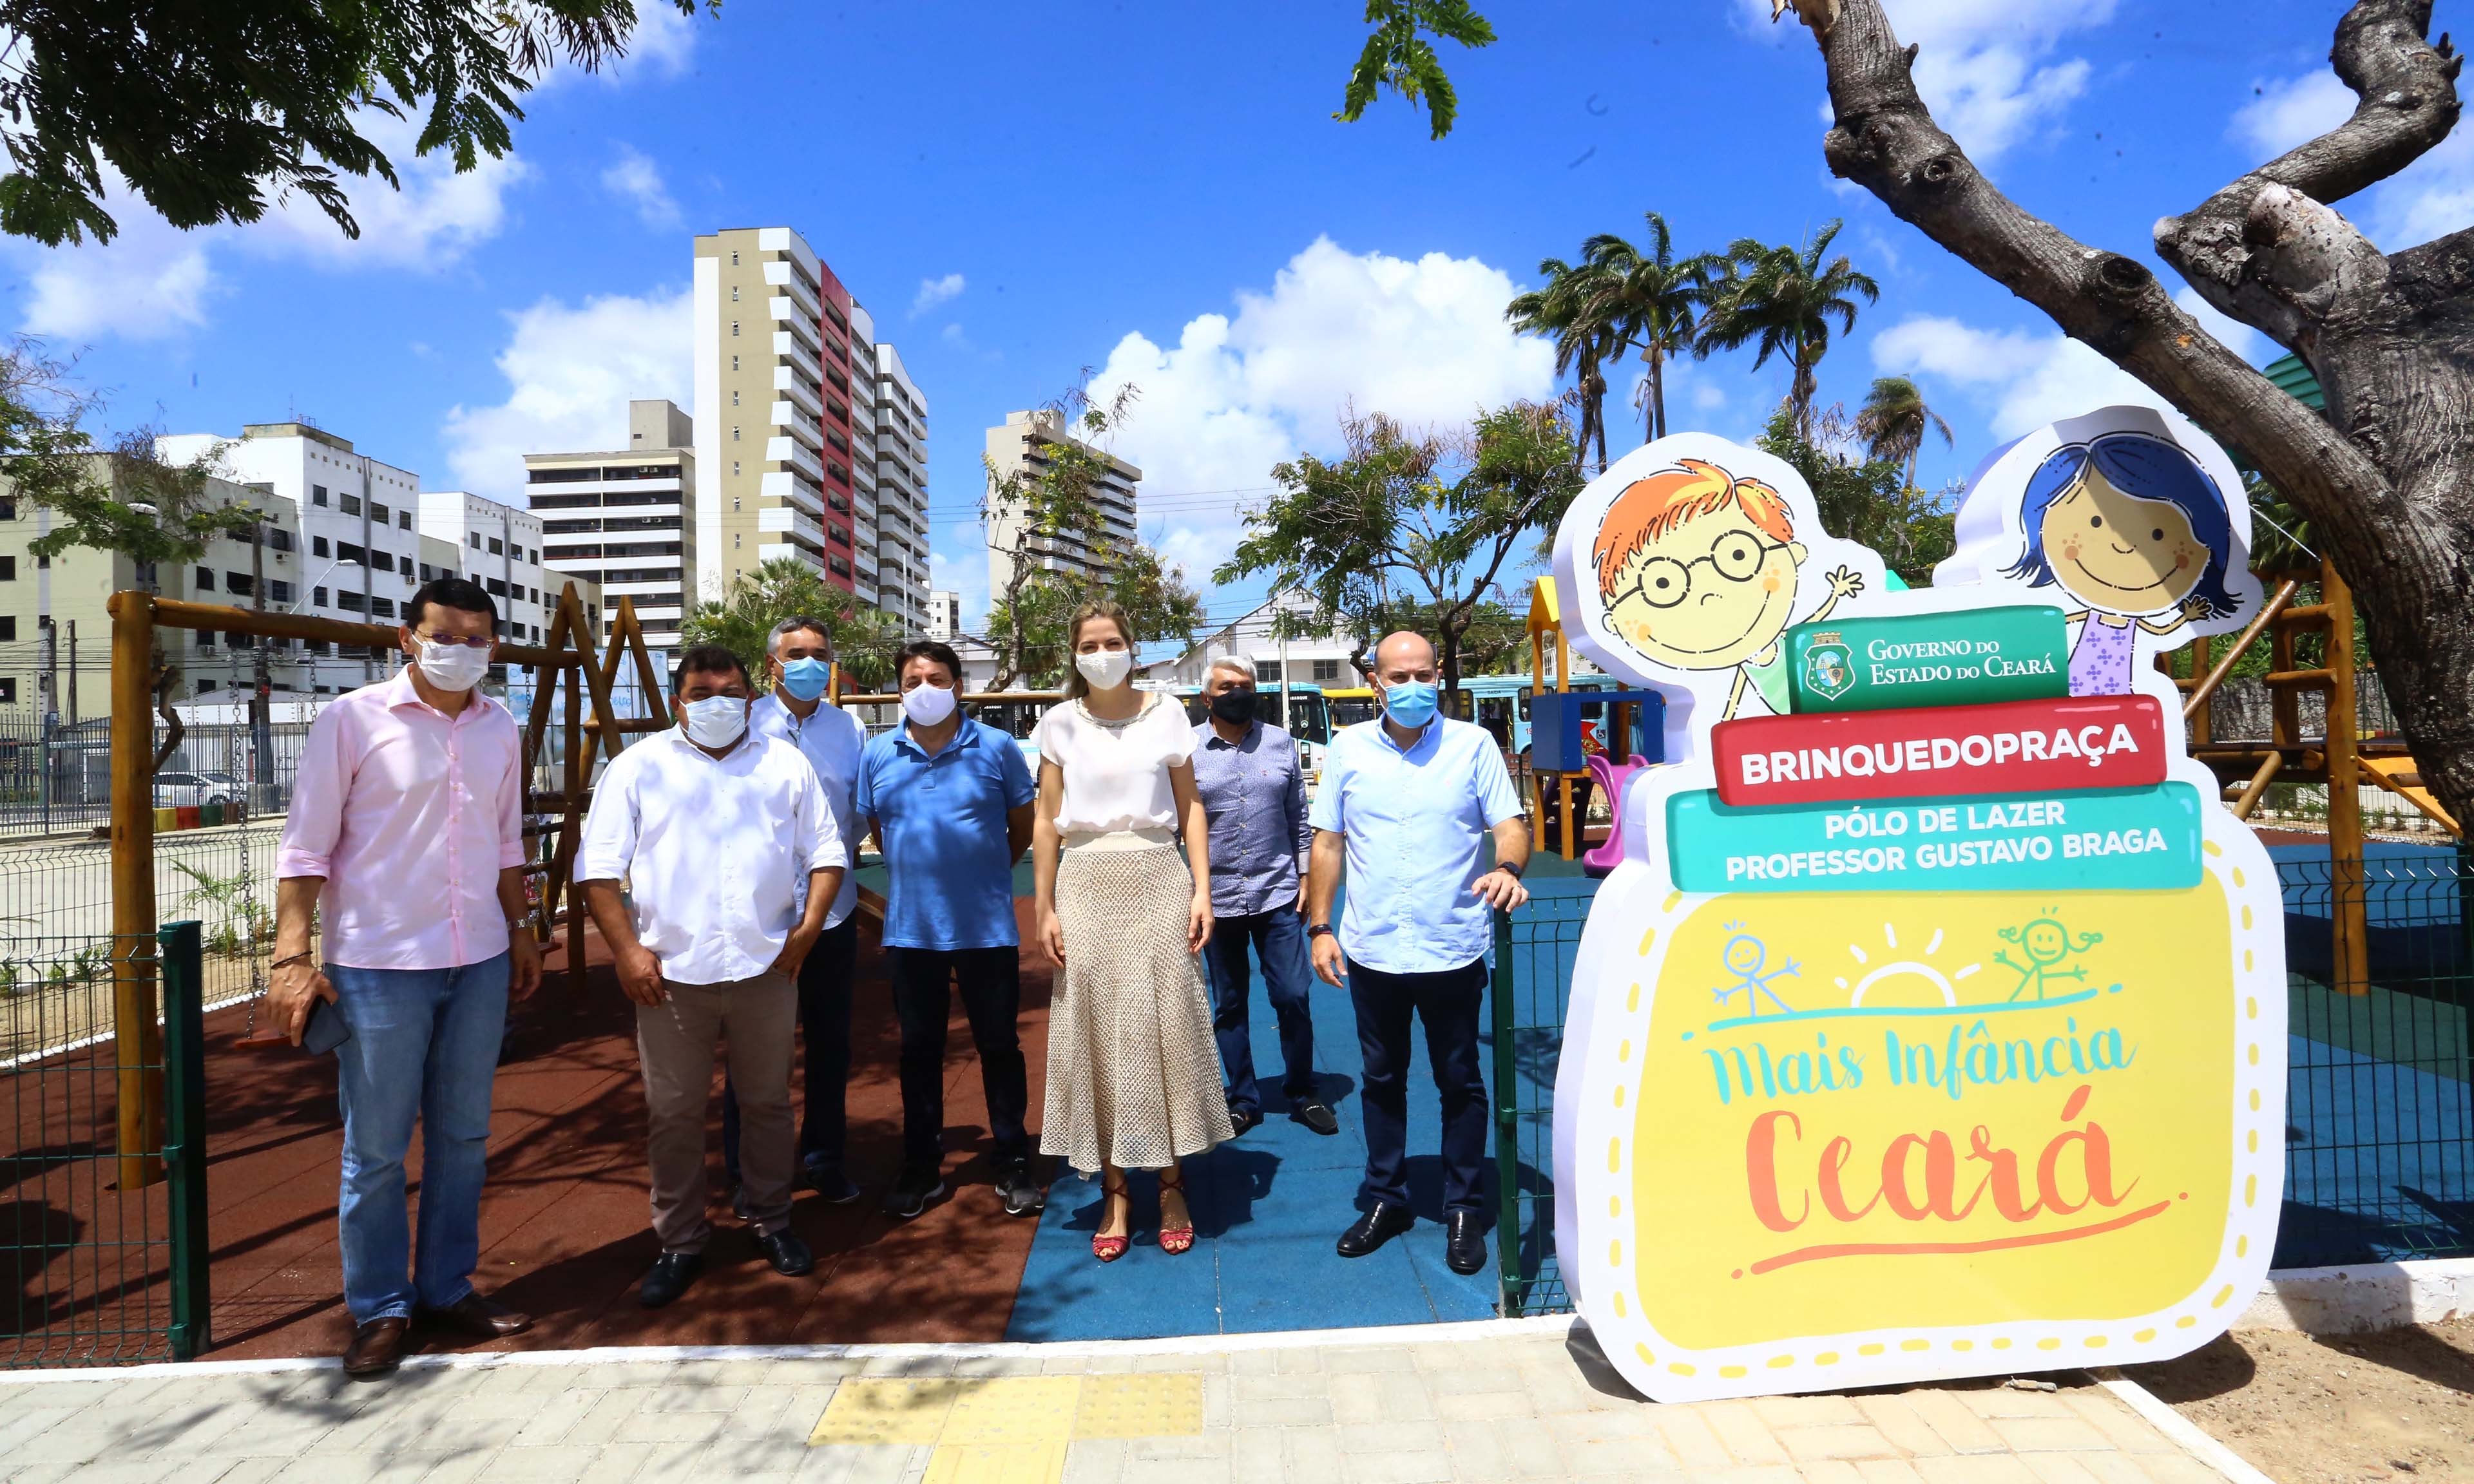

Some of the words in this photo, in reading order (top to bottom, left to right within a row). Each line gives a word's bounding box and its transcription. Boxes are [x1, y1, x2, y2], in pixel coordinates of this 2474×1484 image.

[1868, 639, 1971, 661] GOVERNO
[1868, 663, 1951, 685] ESTADO
[1984, 652, 2057, 678] CEARÁ
[1740, 723, 2140, 786] BRINQUEDOPRAÇA
[1825, 805, 1908, 839] PÓLO
[1917, 807, 1958, 833] DE
[1967, 801, 2067, 830] LAZER
[1726, 846, 1907, 882] PROFESSOR
[1915, 835, 2053, 869] GUSTAVO
[2063, 828, 2168, 858] BRAGA
[1702, 1031, 1867, 1104] Mais
[1884, 1017, 2138, 1101] Infância
[1745, 1084, 2141, 1233] Ceará
